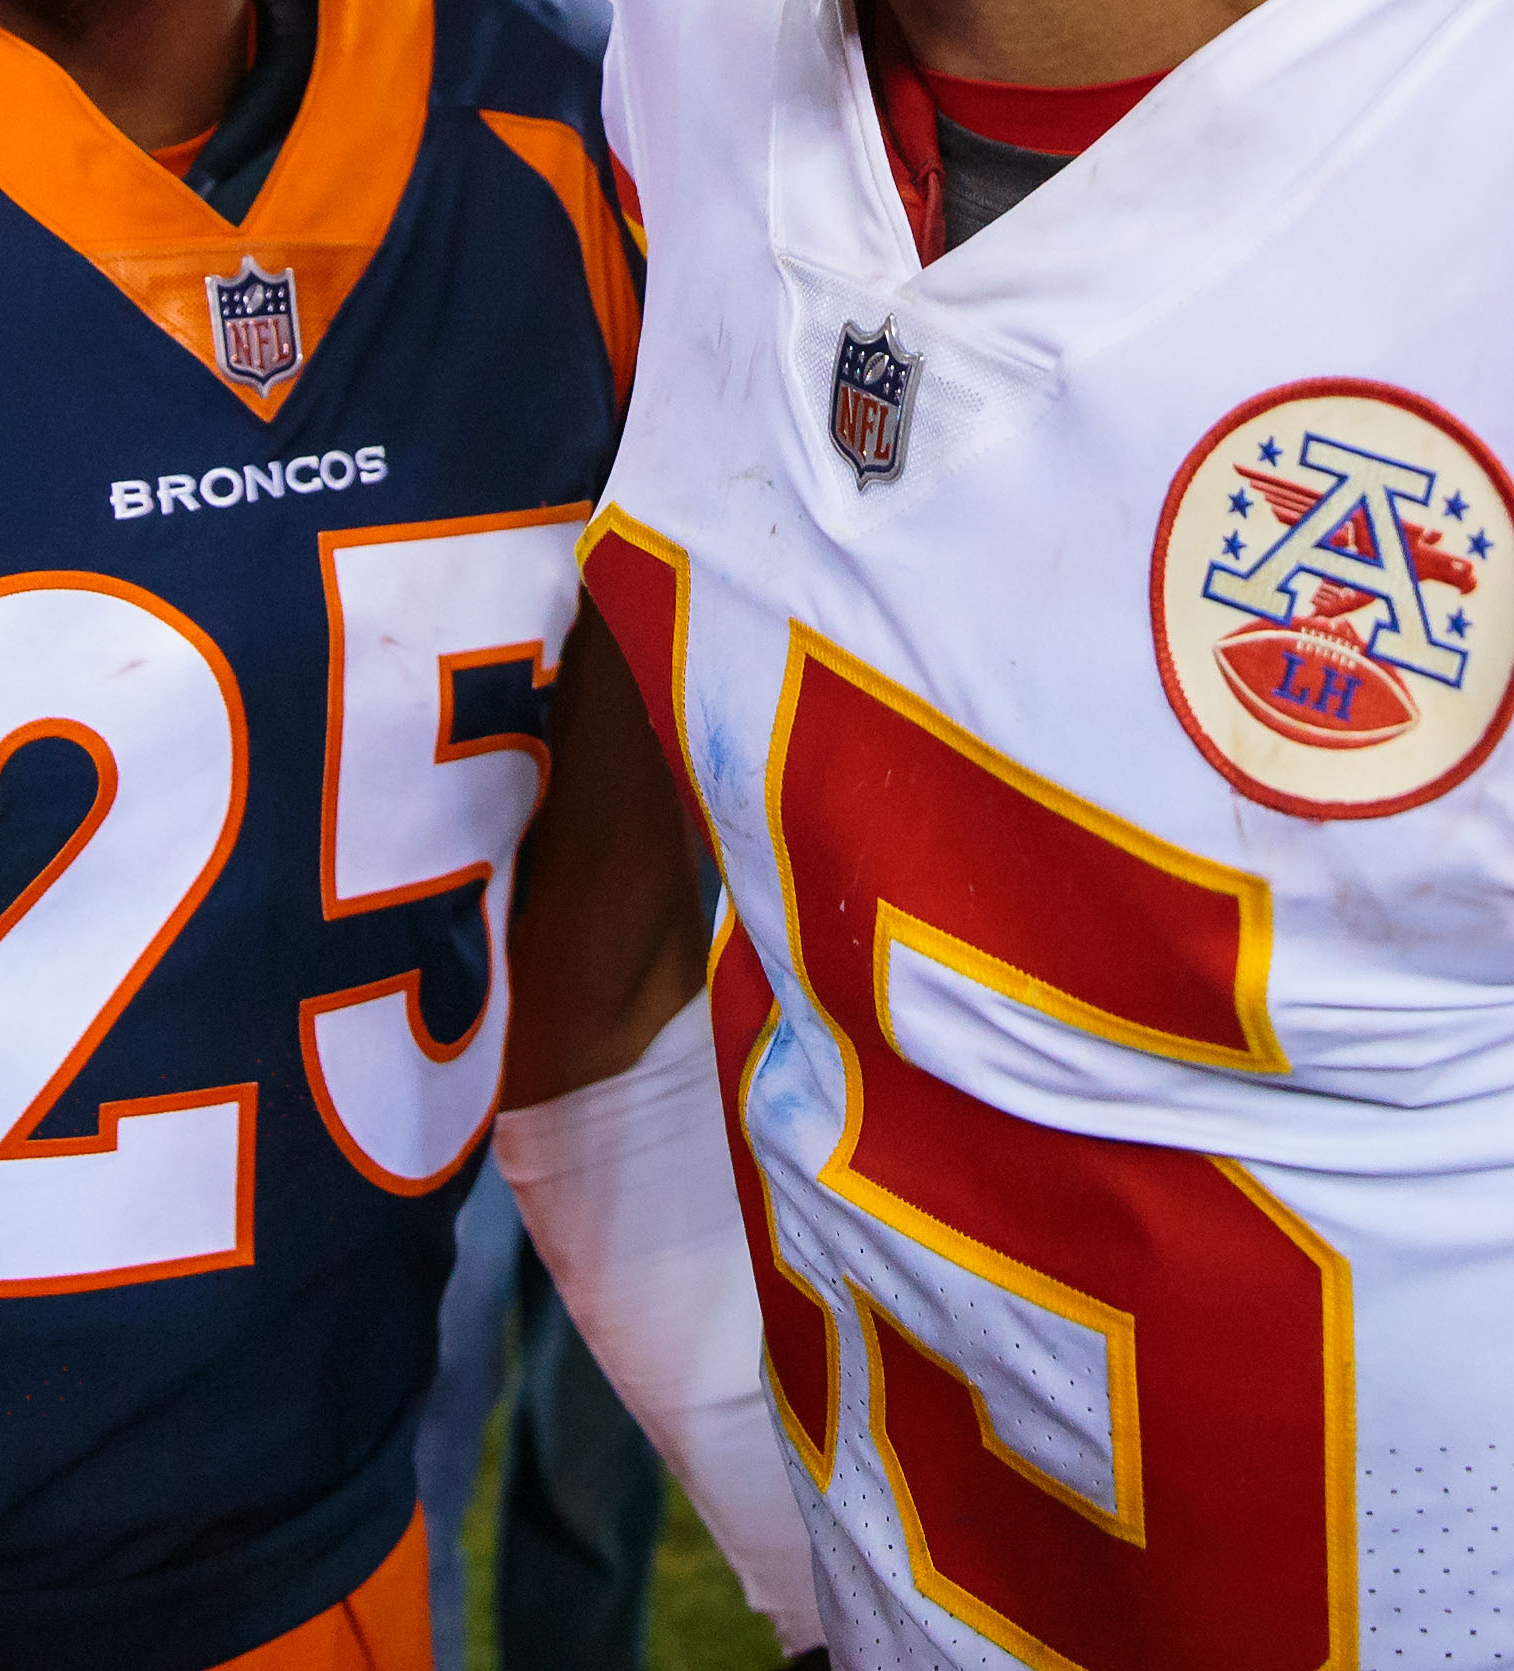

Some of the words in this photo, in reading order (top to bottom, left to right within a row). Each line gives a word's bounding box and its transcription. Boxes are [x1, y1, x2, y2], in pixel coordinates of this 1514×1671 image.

[225, 318, 292, 369] NFL
[836, 385, 893, 462] NFL
[110, 445, 388, 520] BRONCOS
[1201, 431, 1470, 690] A
[1271, 650, 1363, 724] LH
